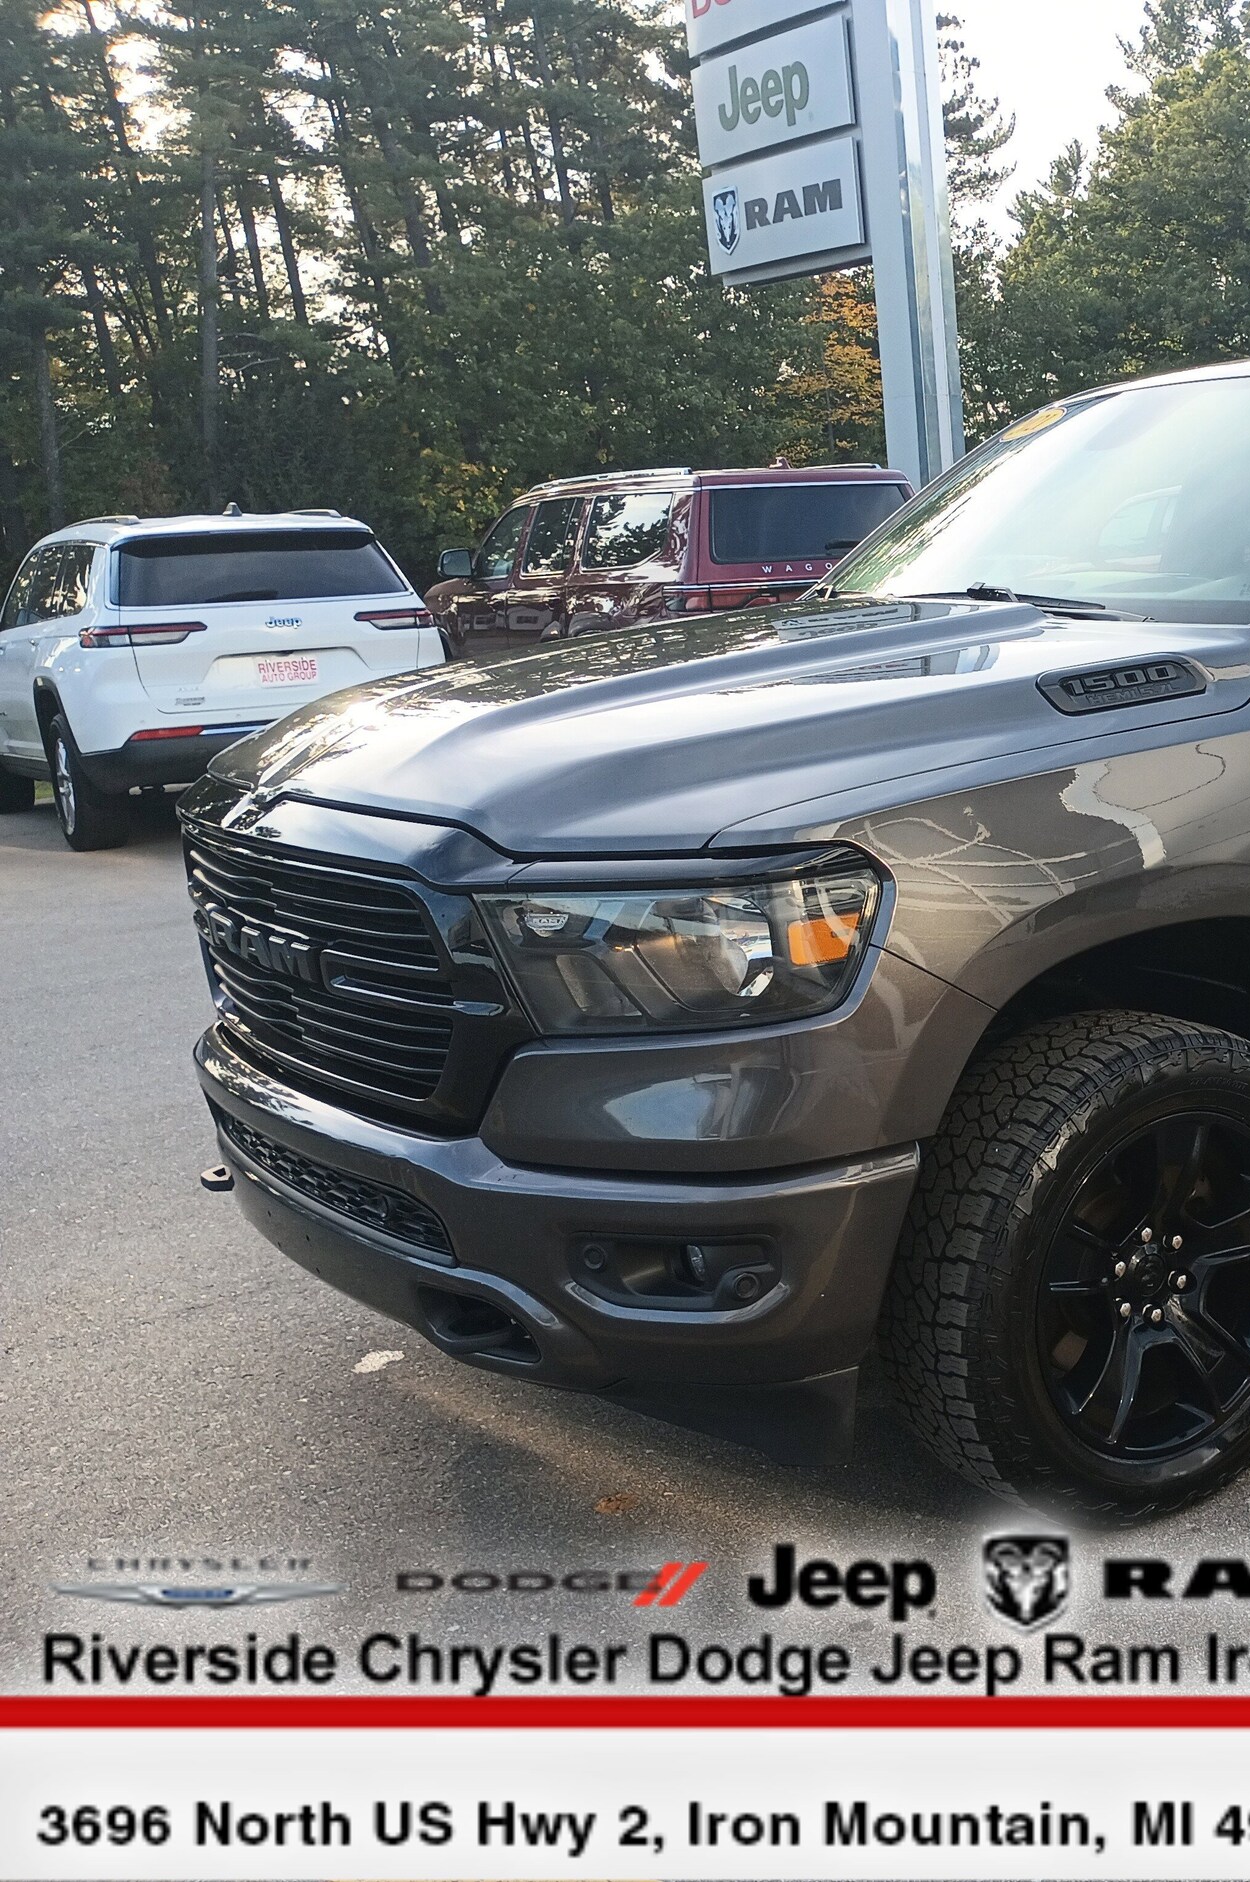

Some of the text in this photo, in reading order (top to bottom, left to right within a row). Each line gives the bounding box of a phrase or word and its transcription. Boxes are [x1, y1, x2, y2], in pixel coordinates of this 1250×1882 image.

[717, 60, 810, 132] Jeep
[743, 178, 843, 231] RAM
[265, 616, 303, 630] Jeep
[258, 659, 317, 674] RIVERSIDE
[262, 671, 317, 683] AUTO GROUP
[1066, 664, 1178, 696] 1500
[209, 910, 316, 982] RAM
